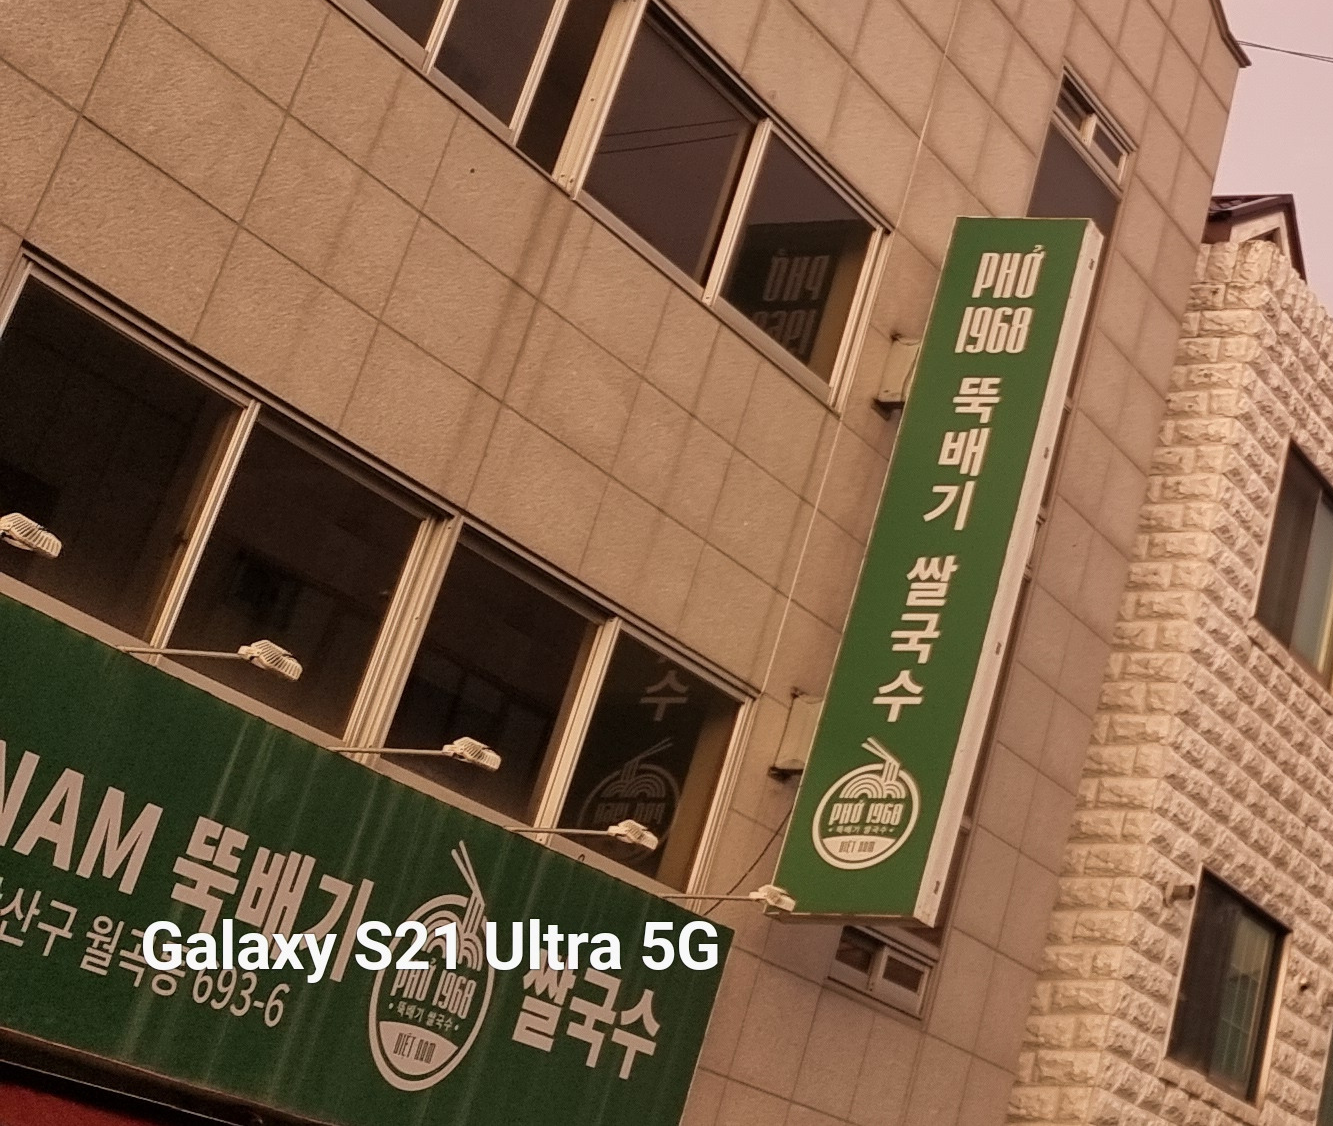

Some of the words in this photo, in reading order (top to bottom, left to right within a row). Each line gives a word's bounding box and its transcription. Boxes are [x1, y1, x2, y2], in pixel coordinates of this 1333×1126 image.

[954, 306, 1033, 356] 1968
[922, 377, 1002, 532] 뚝배기
[872, 555, 958, 724] 쌀국수
[866, 802, 904, 826] 1968
[0, 879, 78, 957] 산구
[192, 965, 290, 1028] 693-6
[171, 816, 374, 982] 뚝배기
[512, 946, 661, 1080] 쌀국수
[432, 969, 477, 1019] 1968
